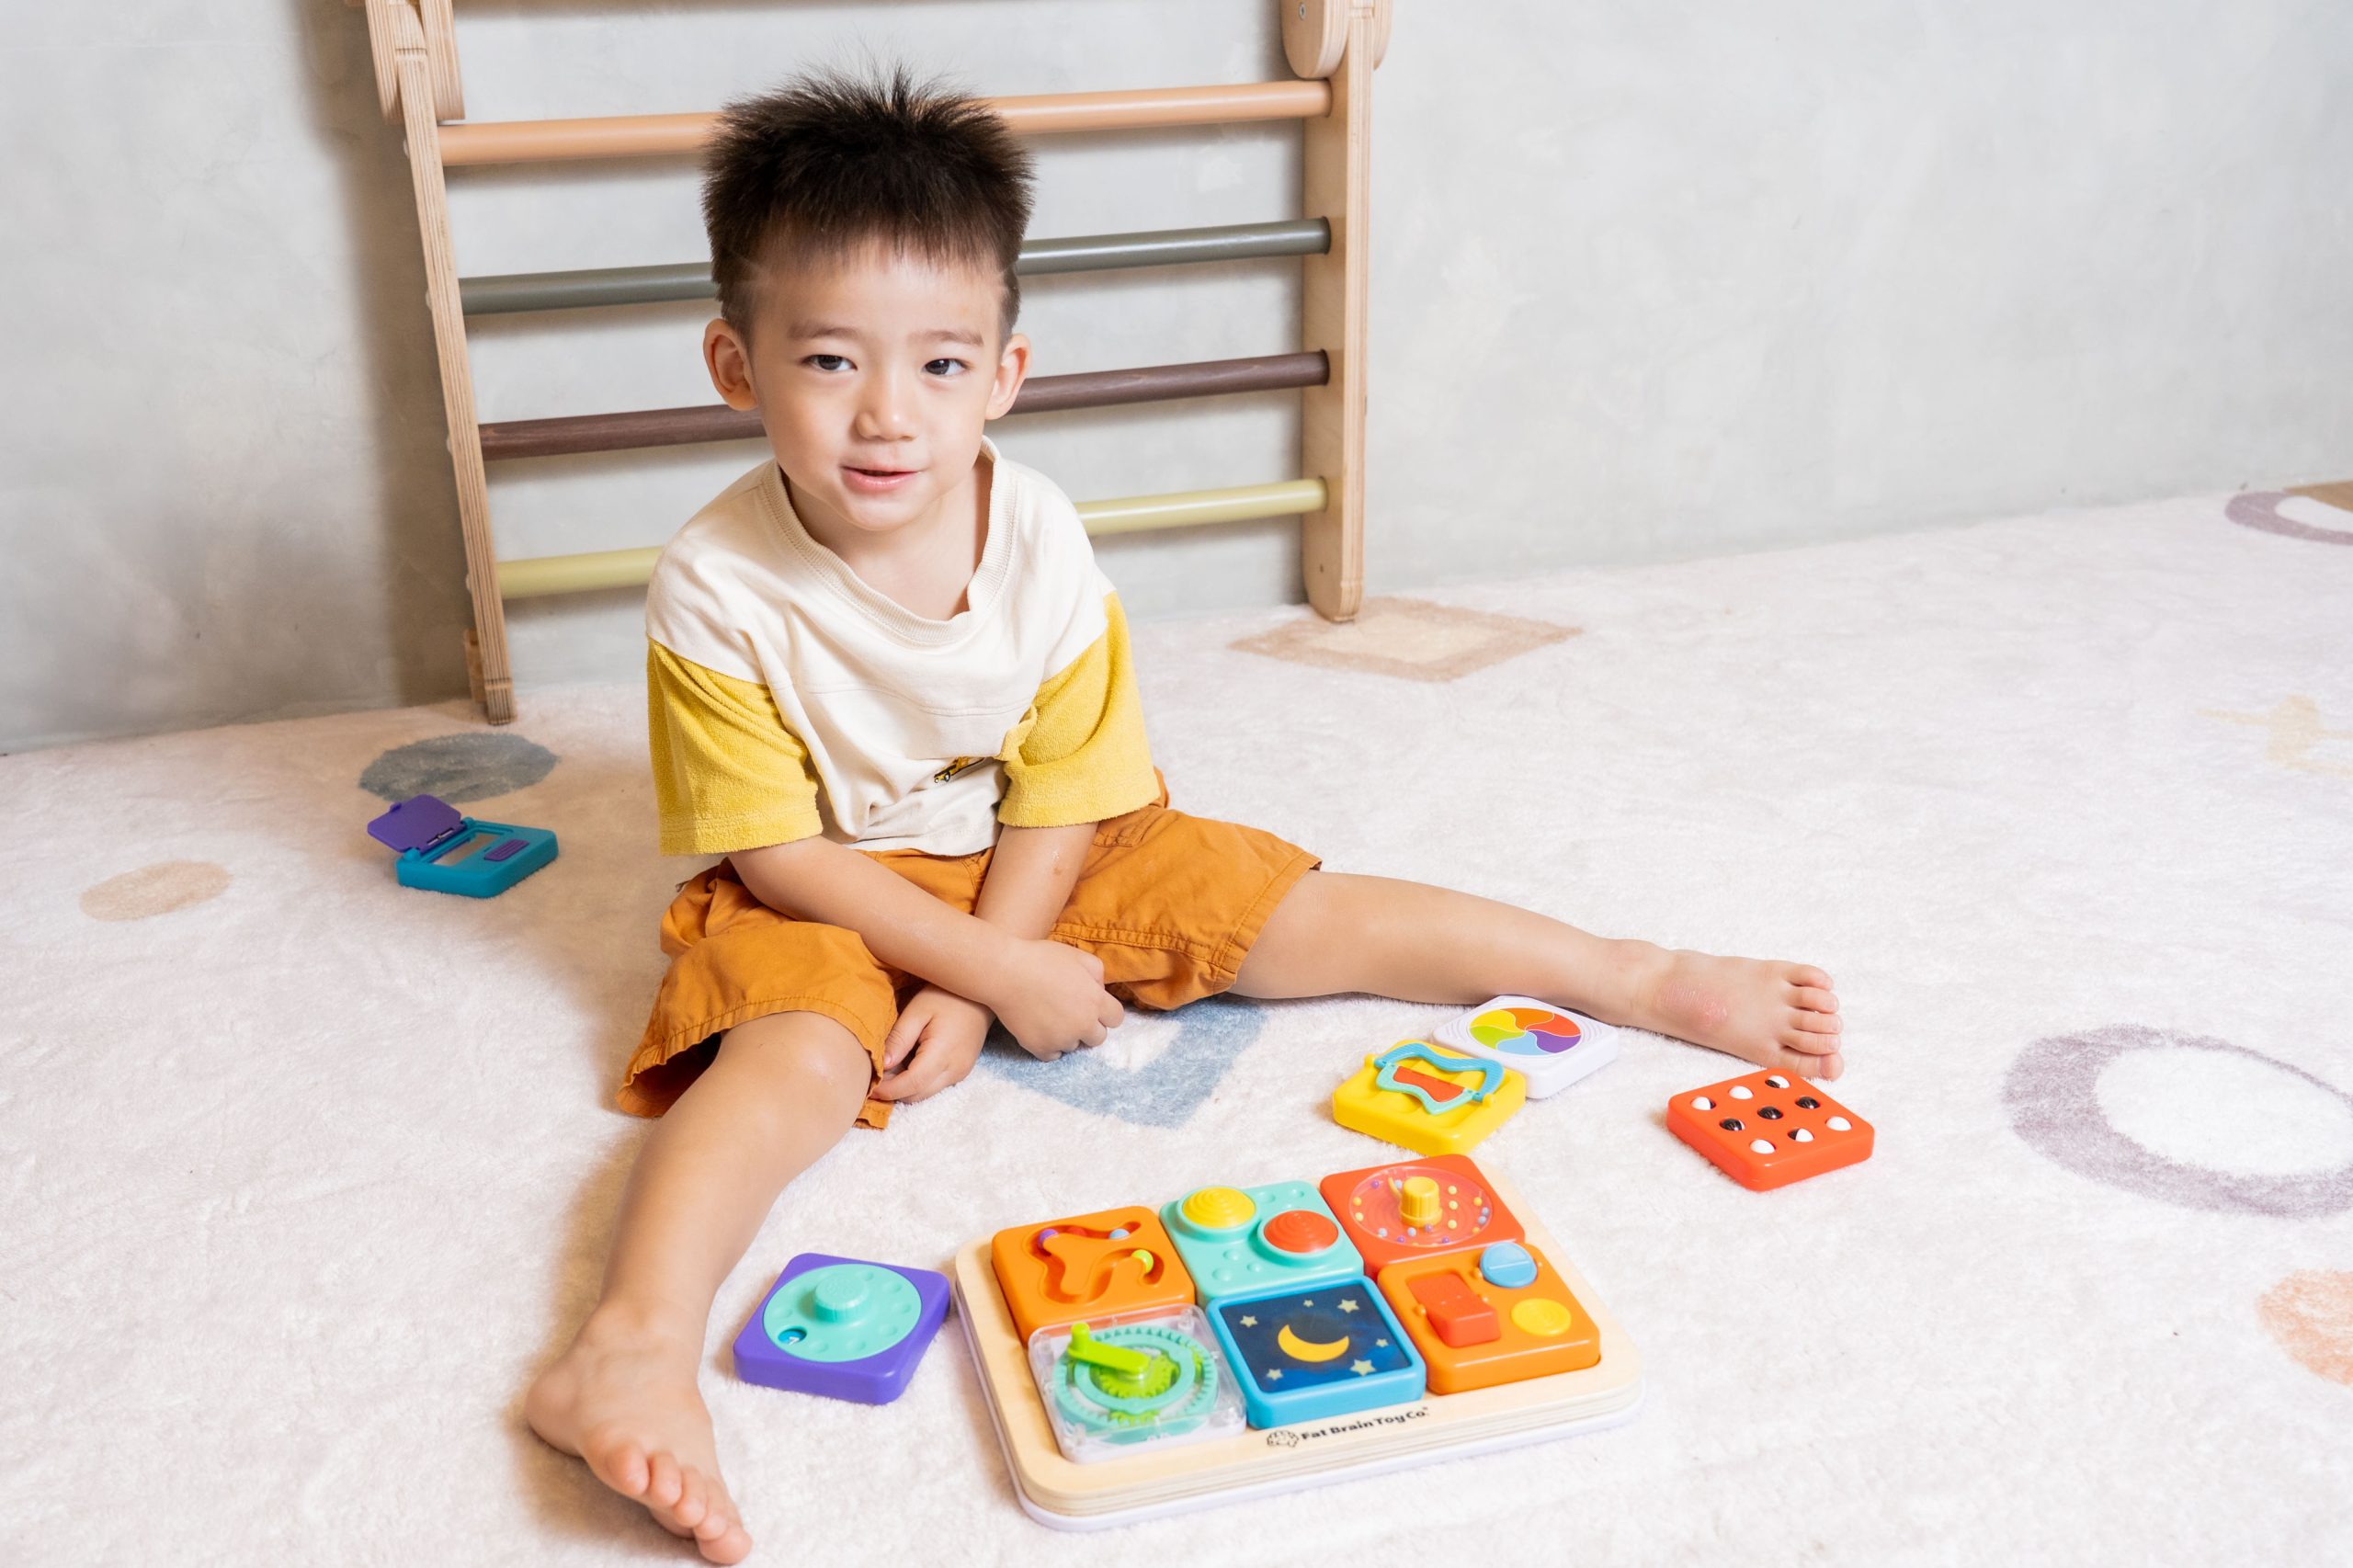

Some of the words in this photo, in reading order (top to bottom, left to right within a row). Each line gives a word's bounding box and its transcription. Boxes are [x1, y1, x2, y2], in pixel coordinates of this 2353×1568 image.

[1301, 1429, 1326, 1440] Fat
[1330, 1420, 1373, 1435] Brain
[1373, 1415, 1405, 1426] Toy
